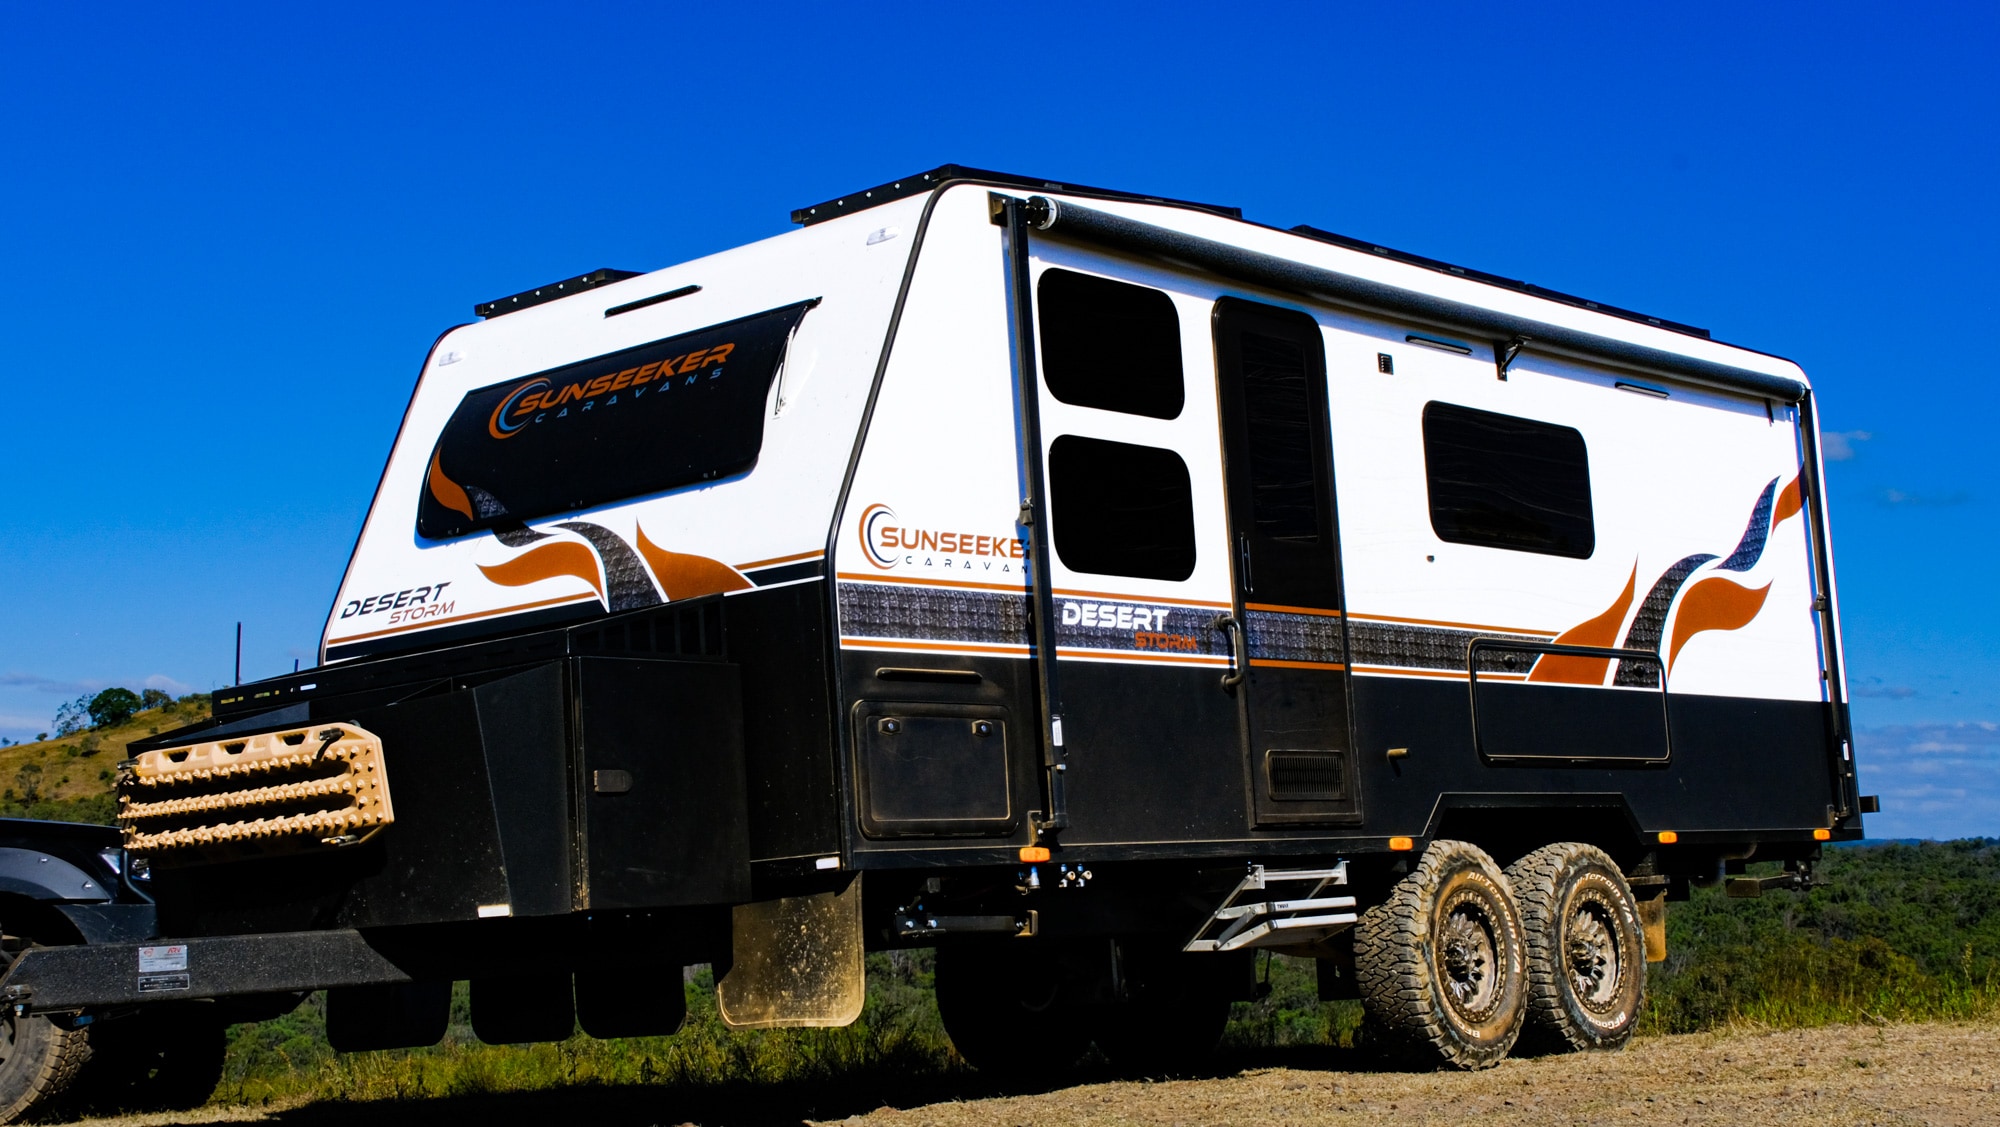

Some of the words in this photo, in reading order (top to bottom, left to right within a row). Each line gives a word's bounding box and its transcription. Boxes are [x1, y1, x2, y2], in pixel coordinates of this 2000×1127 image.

[512, 343, 735, 417] SUNSEEKER
[535, 368, 723, 424] CARAVANS
[905, 556, 1028, 574] CARAVAN
[340, 581, 452, 619] DESERT
[388, 600, 455, 624] STORM
[1062, 602, 1169, 631] DESERT
[1135, 631, 1197, 649] STORM
